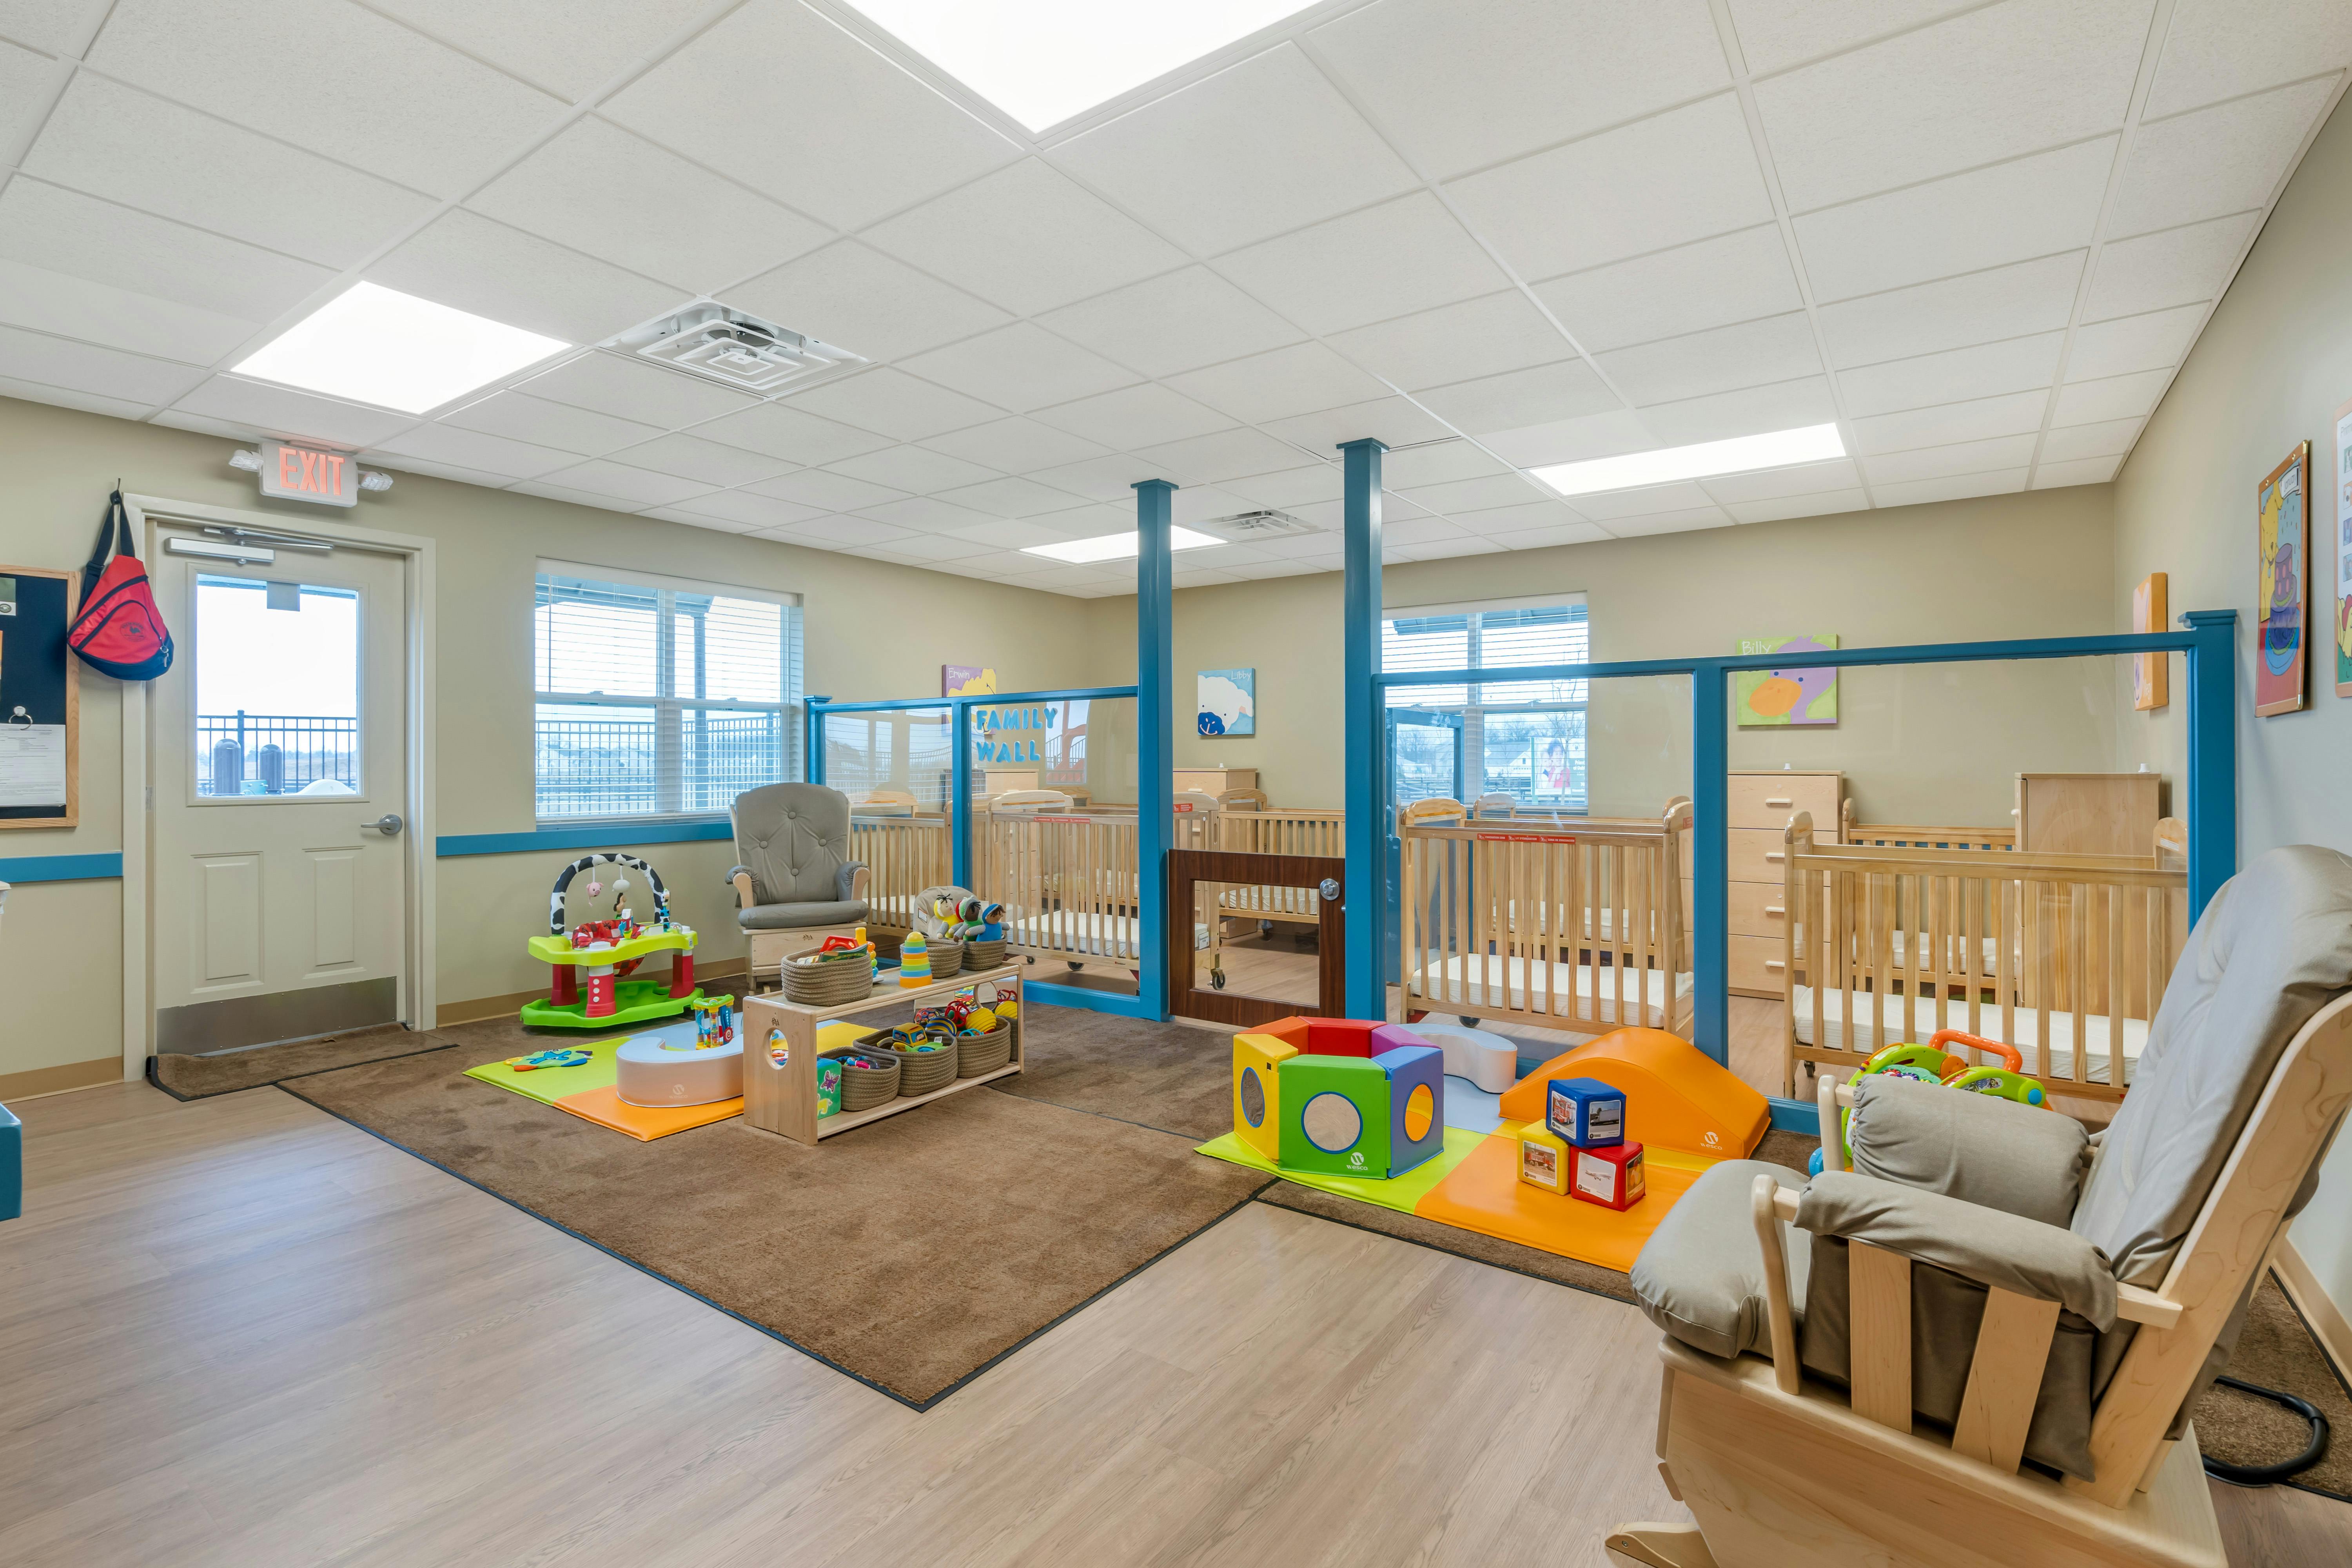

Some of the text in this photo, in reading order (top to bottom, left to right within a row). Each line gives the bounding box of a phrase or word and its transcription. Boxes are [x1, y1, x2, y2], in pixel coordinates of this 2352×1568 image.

[279, 447, 345, 495] EXIT
[1742, 641, 1771, 655] Billy
[948, 668, 970, 679] Erwin
[1231, 671, 1251, 681] Libby
[976, 708, 1058, 730] FAMILY
[976, 740, 1041, 763] WALL
